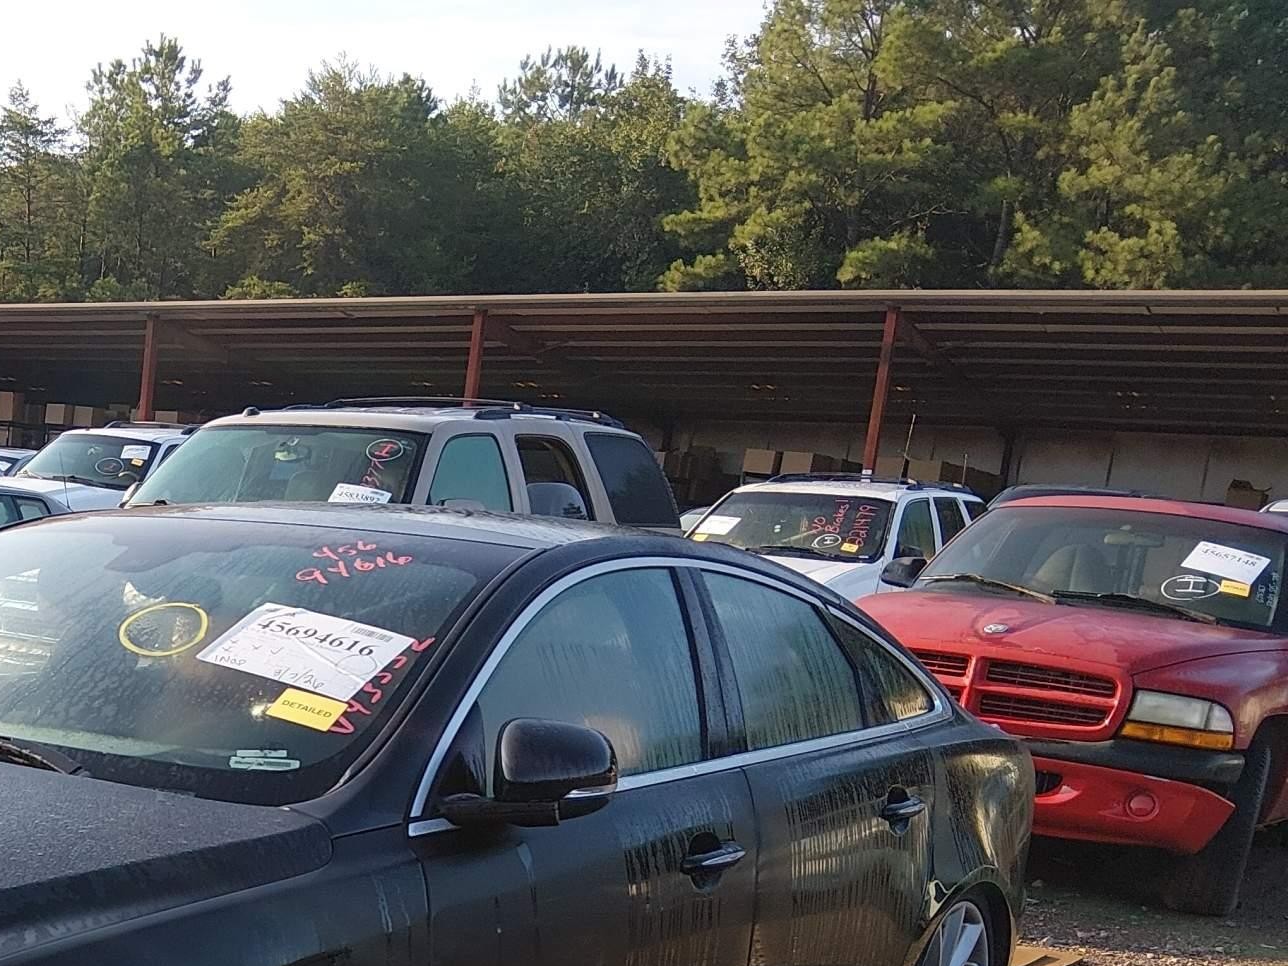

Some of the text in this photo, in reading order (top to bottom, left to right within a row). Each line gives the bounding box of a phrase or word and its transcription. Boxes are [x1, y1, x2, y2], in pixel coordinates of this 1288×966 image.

[312, 540, 377, 561] 456
[295, 552, 413, 585] 94616
[258, 619, 380, 656] 45694616
[282, 699, 332, 718] DETAILED
